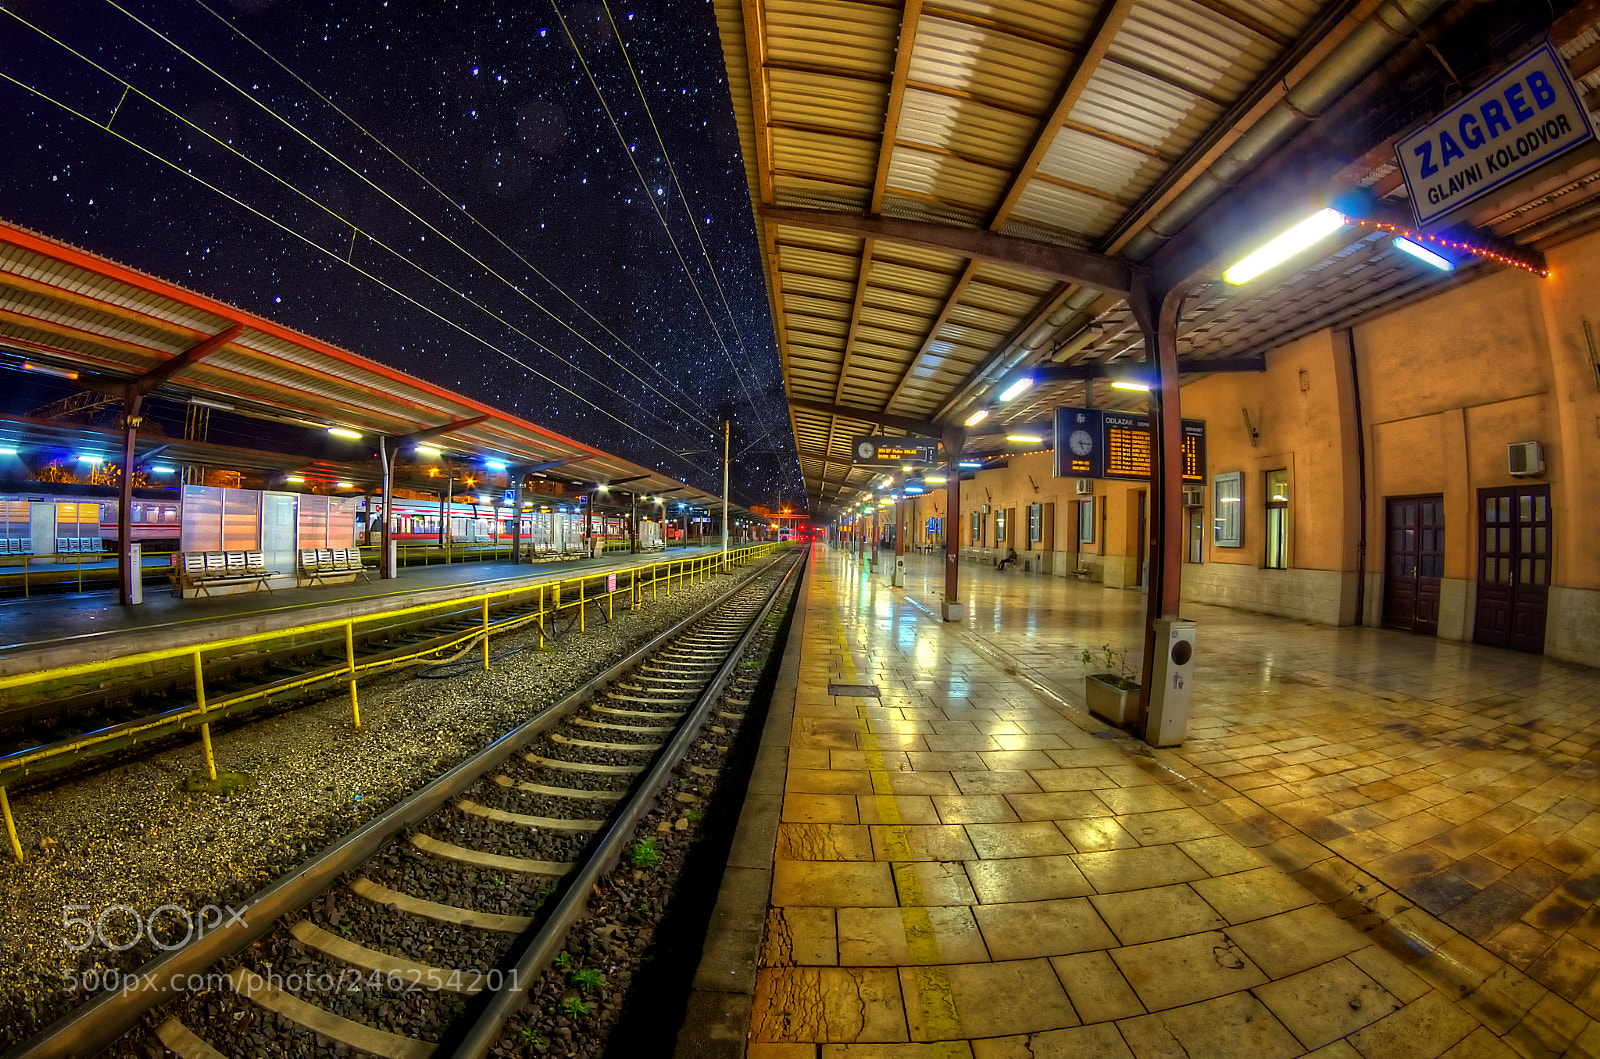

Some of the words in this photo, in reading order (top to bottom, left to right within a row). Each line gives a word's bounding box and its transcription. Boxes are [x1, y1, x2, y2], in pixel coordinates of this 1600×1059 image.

[1414, 71, 1556, 180] ZAGREB
[1427, 163, 1483, 205] GLAVNI
[1485, 114, 1572, 174] KOLODVOR
[1105, 417, 1133, 426] ODLAZAK
